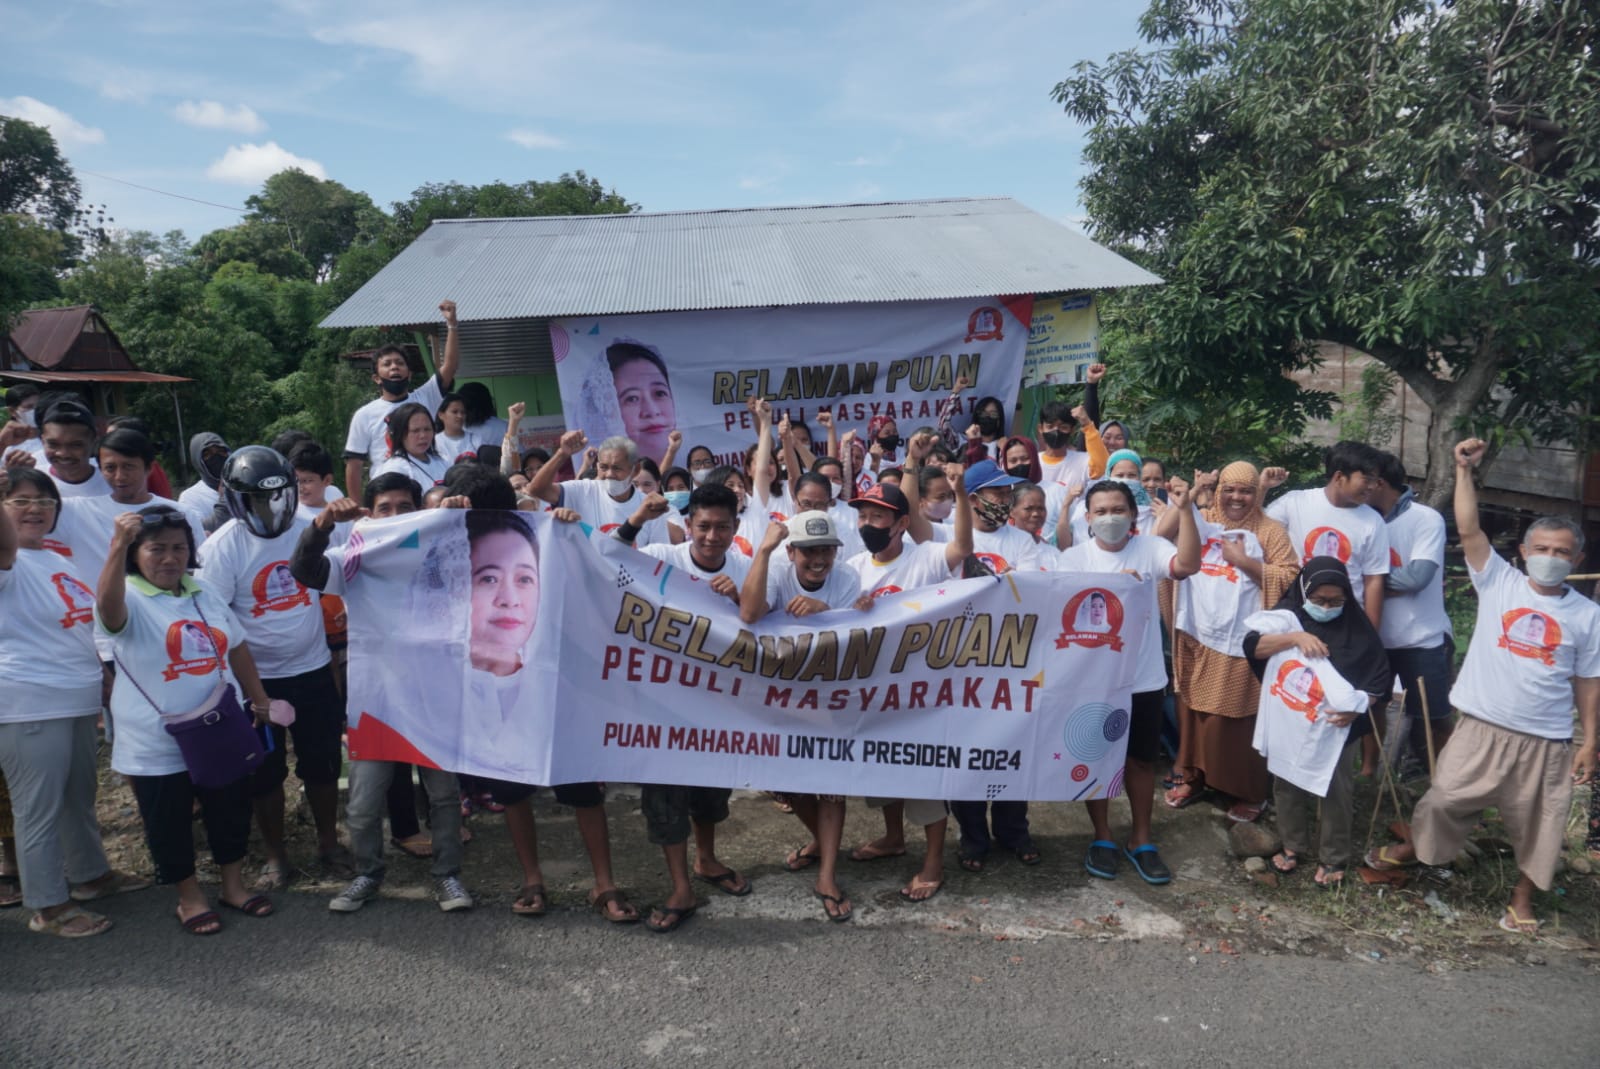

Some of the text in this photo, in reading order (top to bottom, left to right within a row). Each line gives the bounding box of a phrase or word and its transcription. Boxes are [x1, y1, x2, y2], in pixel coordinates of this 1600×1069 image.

[712, 353, 981, 405] RELAWAN PUAN
[724, 407, 804, 432] PEUI
[615, 591, 1039, 681] RELAWAN PUAN
[601, 645, 1040, 713] PEDULI MASYARAKAT
[603, 722, 1021, 771] PUAN MAHARANI UNTUK PRESIDEN 2024
